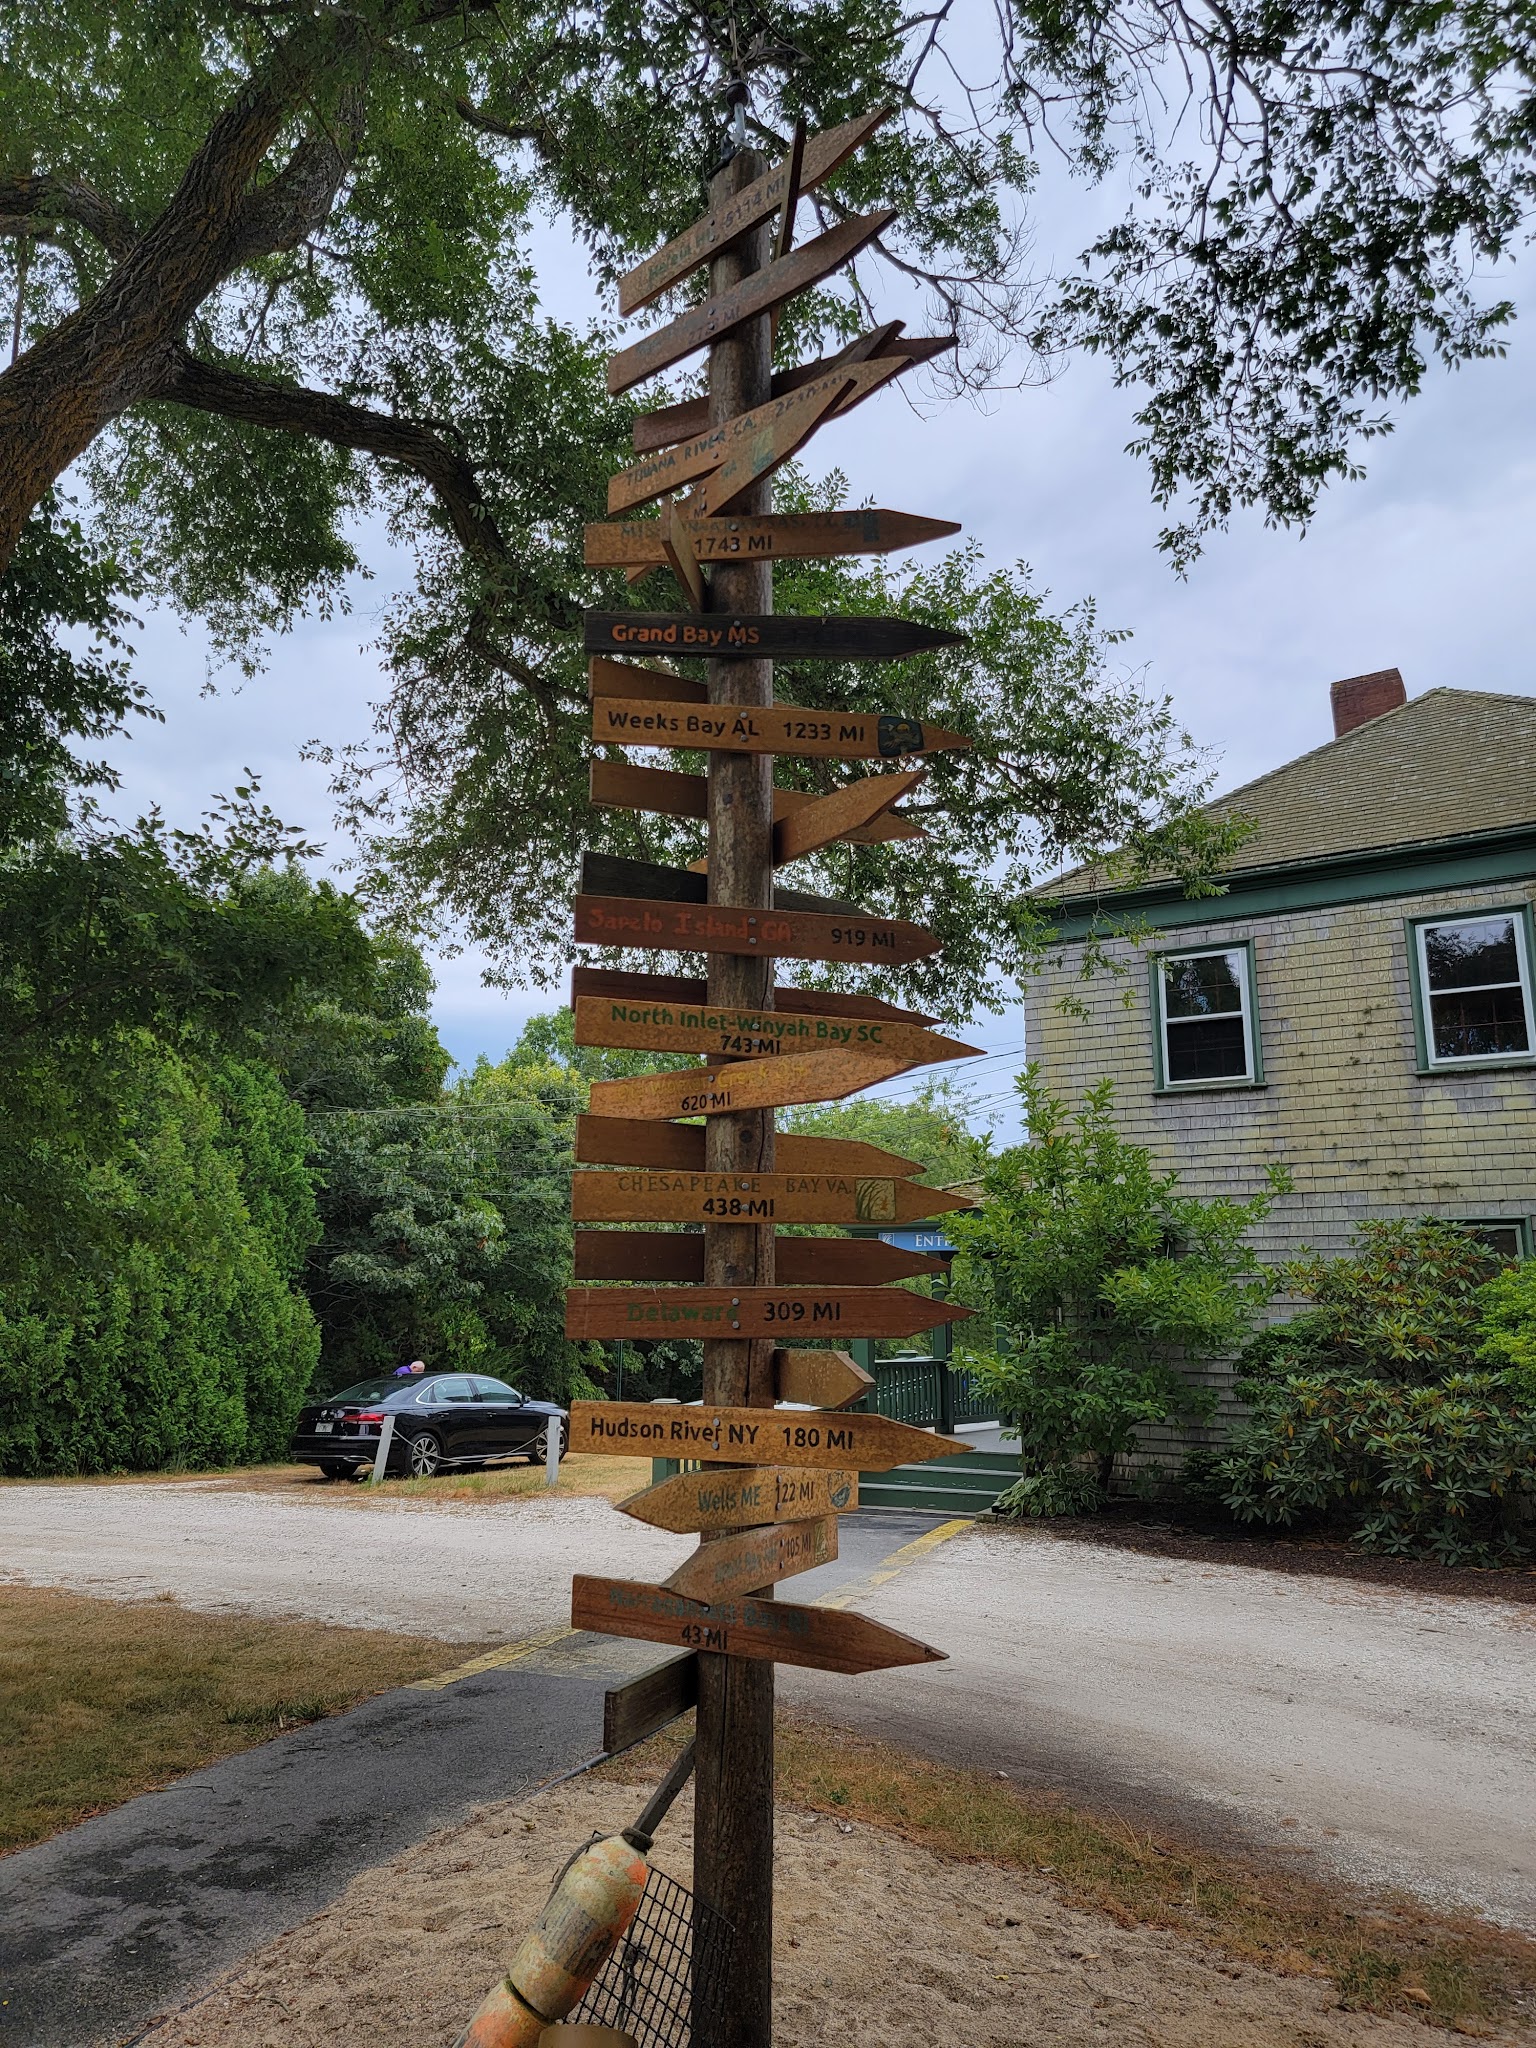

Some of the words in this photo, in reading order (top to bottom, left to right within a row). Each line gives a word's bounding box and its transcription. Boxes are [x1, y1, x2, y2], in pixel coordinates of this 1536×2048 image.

[626, 455, 676, 486] TIJUANA
[684, 429, 726, 460] RIVER
[694, 536, 741, 555] 1743
[748, 534, 773, 551] MI
[611, 624, 677, 643] Grand
[683, 625, 722, 647] Bay
[727, 626, 761, 645] MS
[608, 711, 679, 732] Weeks
[687, 716, 726, 737] Bay
[731, 719, 760, 737] AL
[783, 721, 832, 740] 1233
[839, 725, 864, 742] MI
[673, 911, 748, 940] Island
[831, 927, 866, 947] 919
[872, 930, 896, 949] MI
[612, 1005, 673, 1026] North
[816, 1021, 853, 1044] Bay
[857, 1025, 883, 1044] SC
[720, 1035, 752, 1053] 743
[759, 1038, 781, 1055] MI
[681, 1094, 707, 1111] 620
[712, 1091, 731, 1110] MI
[618, 1176, 760, 1194] CHESAPEAKE
[785, 1178, 818, 1194] BAY
[702, 1198, 741, 1217] 438
[749, 1199, 775, 1218] MI
[763, 1302, 805, 1322] 309
[812, 1302, 841, 1322] MI
[591, 1417, 664, 1439] Hudson
[670, 1420, 722, 1442] River
[728, 1424, 760, 1444] NY
[782, 1427, 820, 1447] 180
[826, 1430, 854, 1450] MI
[697, 1487, 737, 1512] Wells
[741, 1486, 761, 1508] ME
[775, 1482, 796, 1505] 122
[799, 1481, 814, 1500] MI
[785, 1536, 800, 1559] 105
[802, 1532, 812, 1555] MI
[682, 1624, 700, 1644] 43
[706, 1625, 728, 1650] MI
